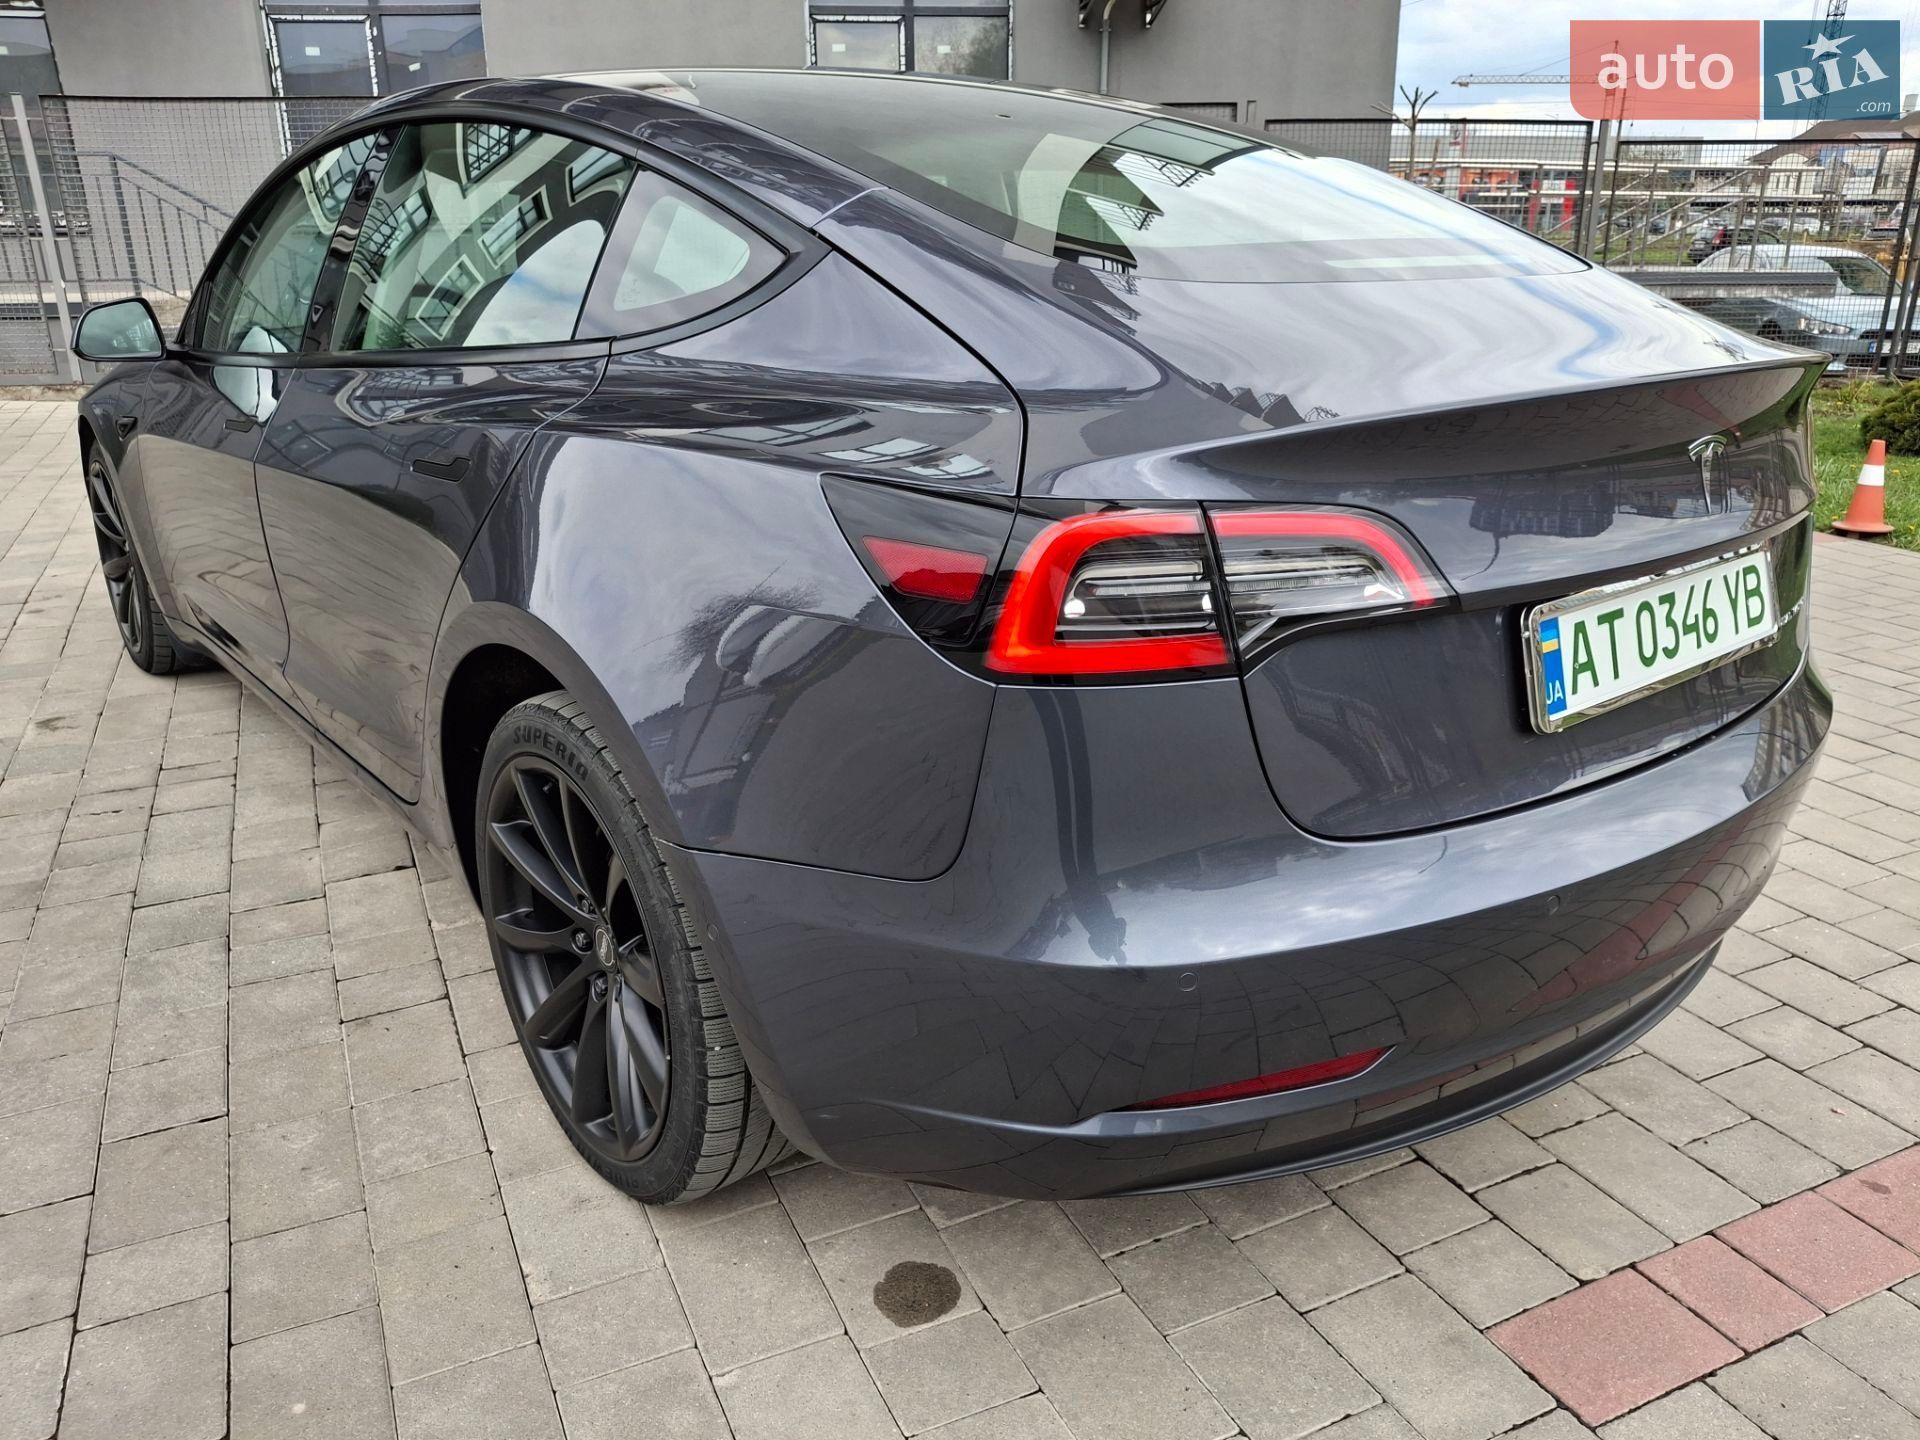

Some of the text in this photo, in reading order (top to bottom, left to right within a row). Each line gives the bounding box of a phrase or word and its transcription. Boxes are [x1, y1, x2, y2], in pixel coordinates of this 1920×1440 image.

[1572, 564, 1765, 695] AT 0346 YB
